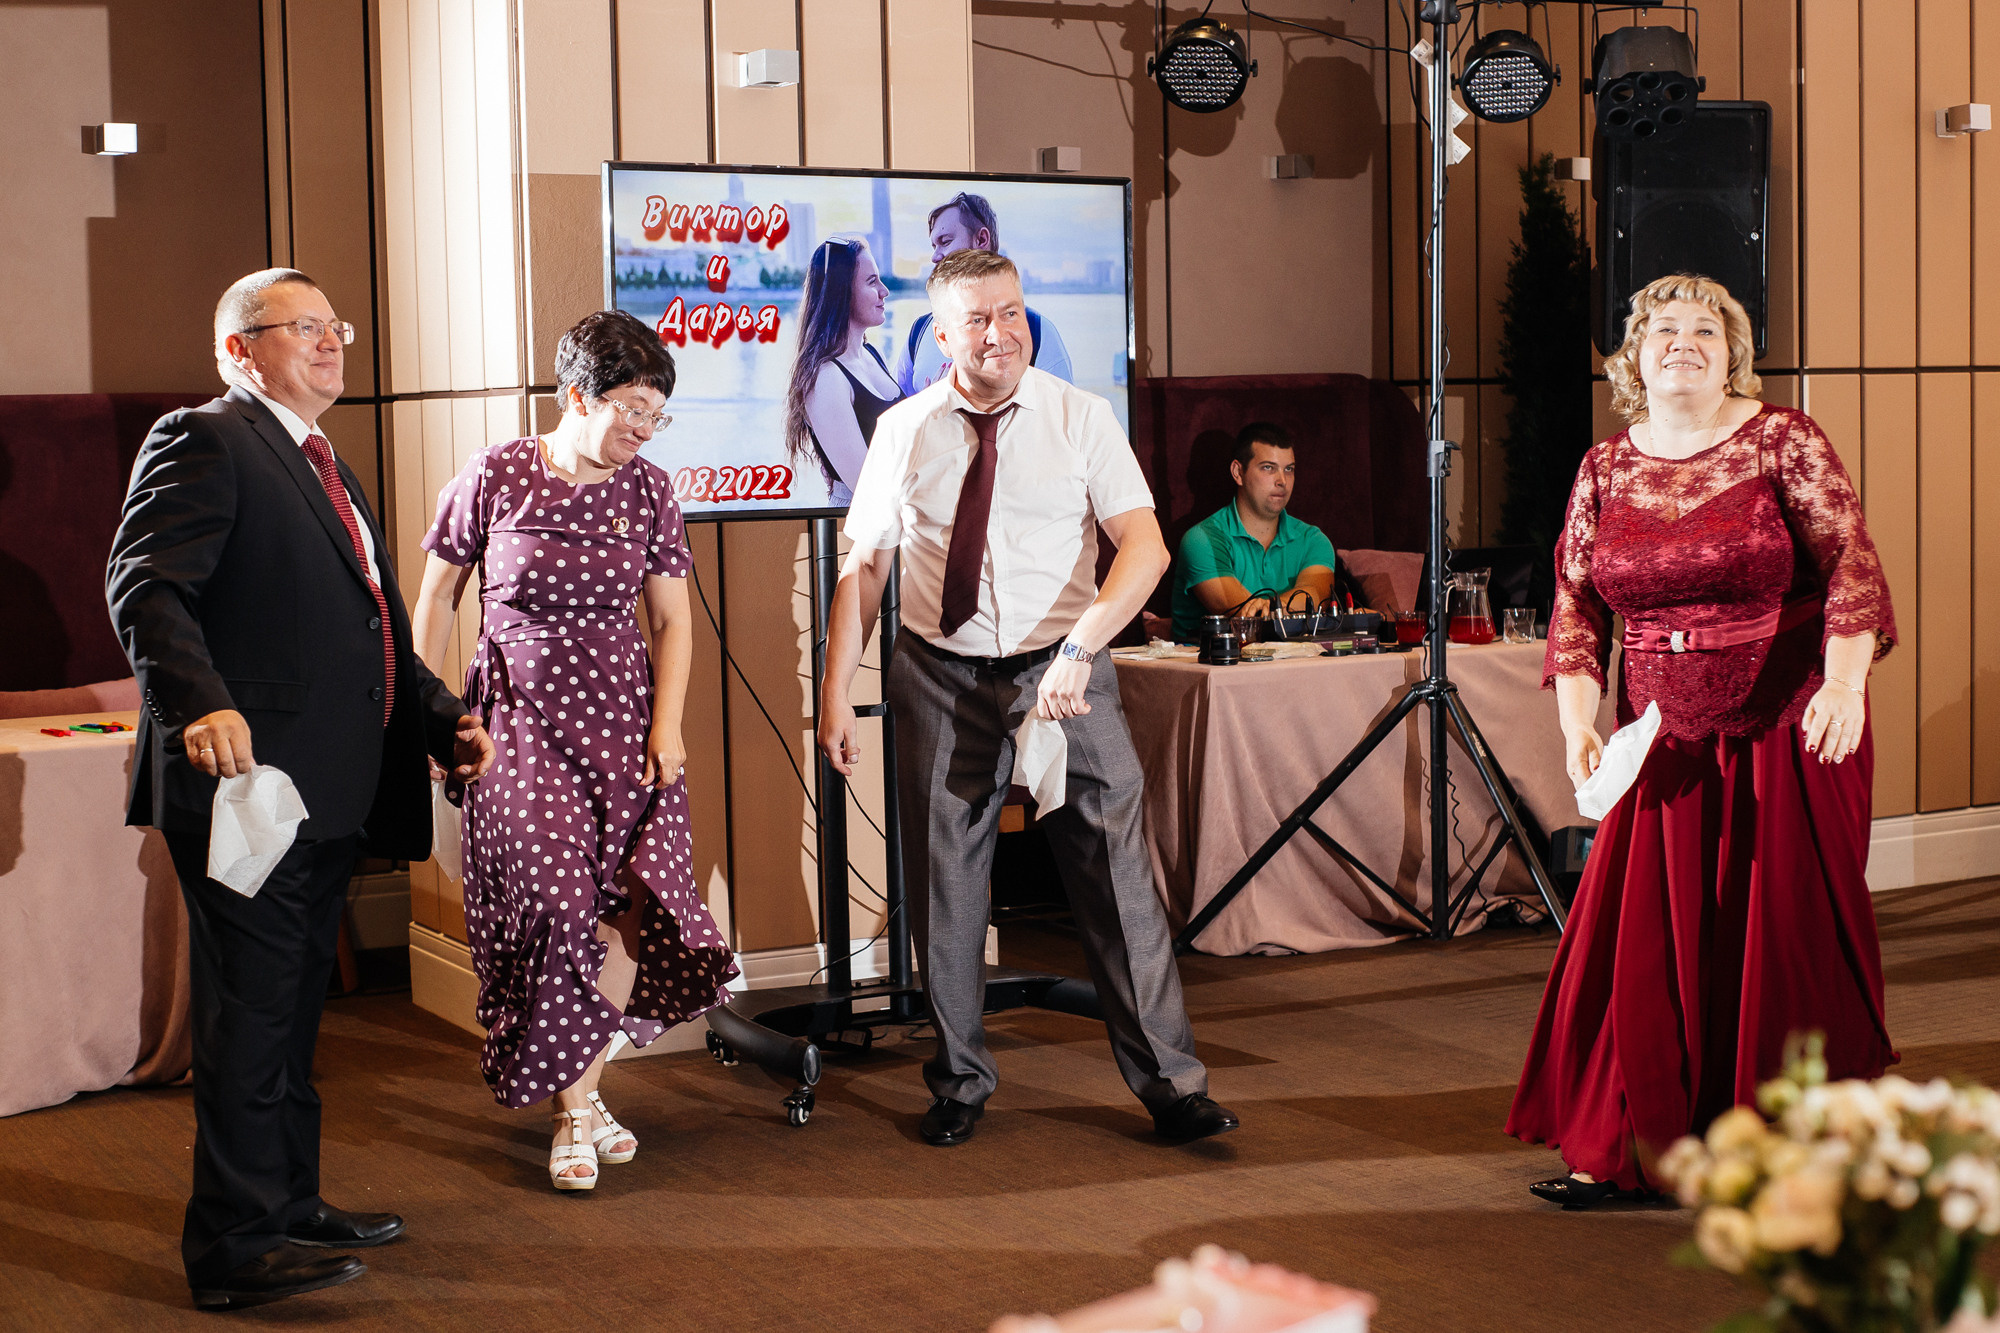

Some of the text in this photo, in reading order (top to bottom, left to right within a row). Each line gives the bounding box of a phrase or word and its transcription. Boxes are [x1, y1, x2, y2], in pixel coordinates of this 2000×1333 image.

[642, 195, 789, 244] Виктор
[706, 255, 730, 284] и
[657, 296, 779, 343] Дарья
